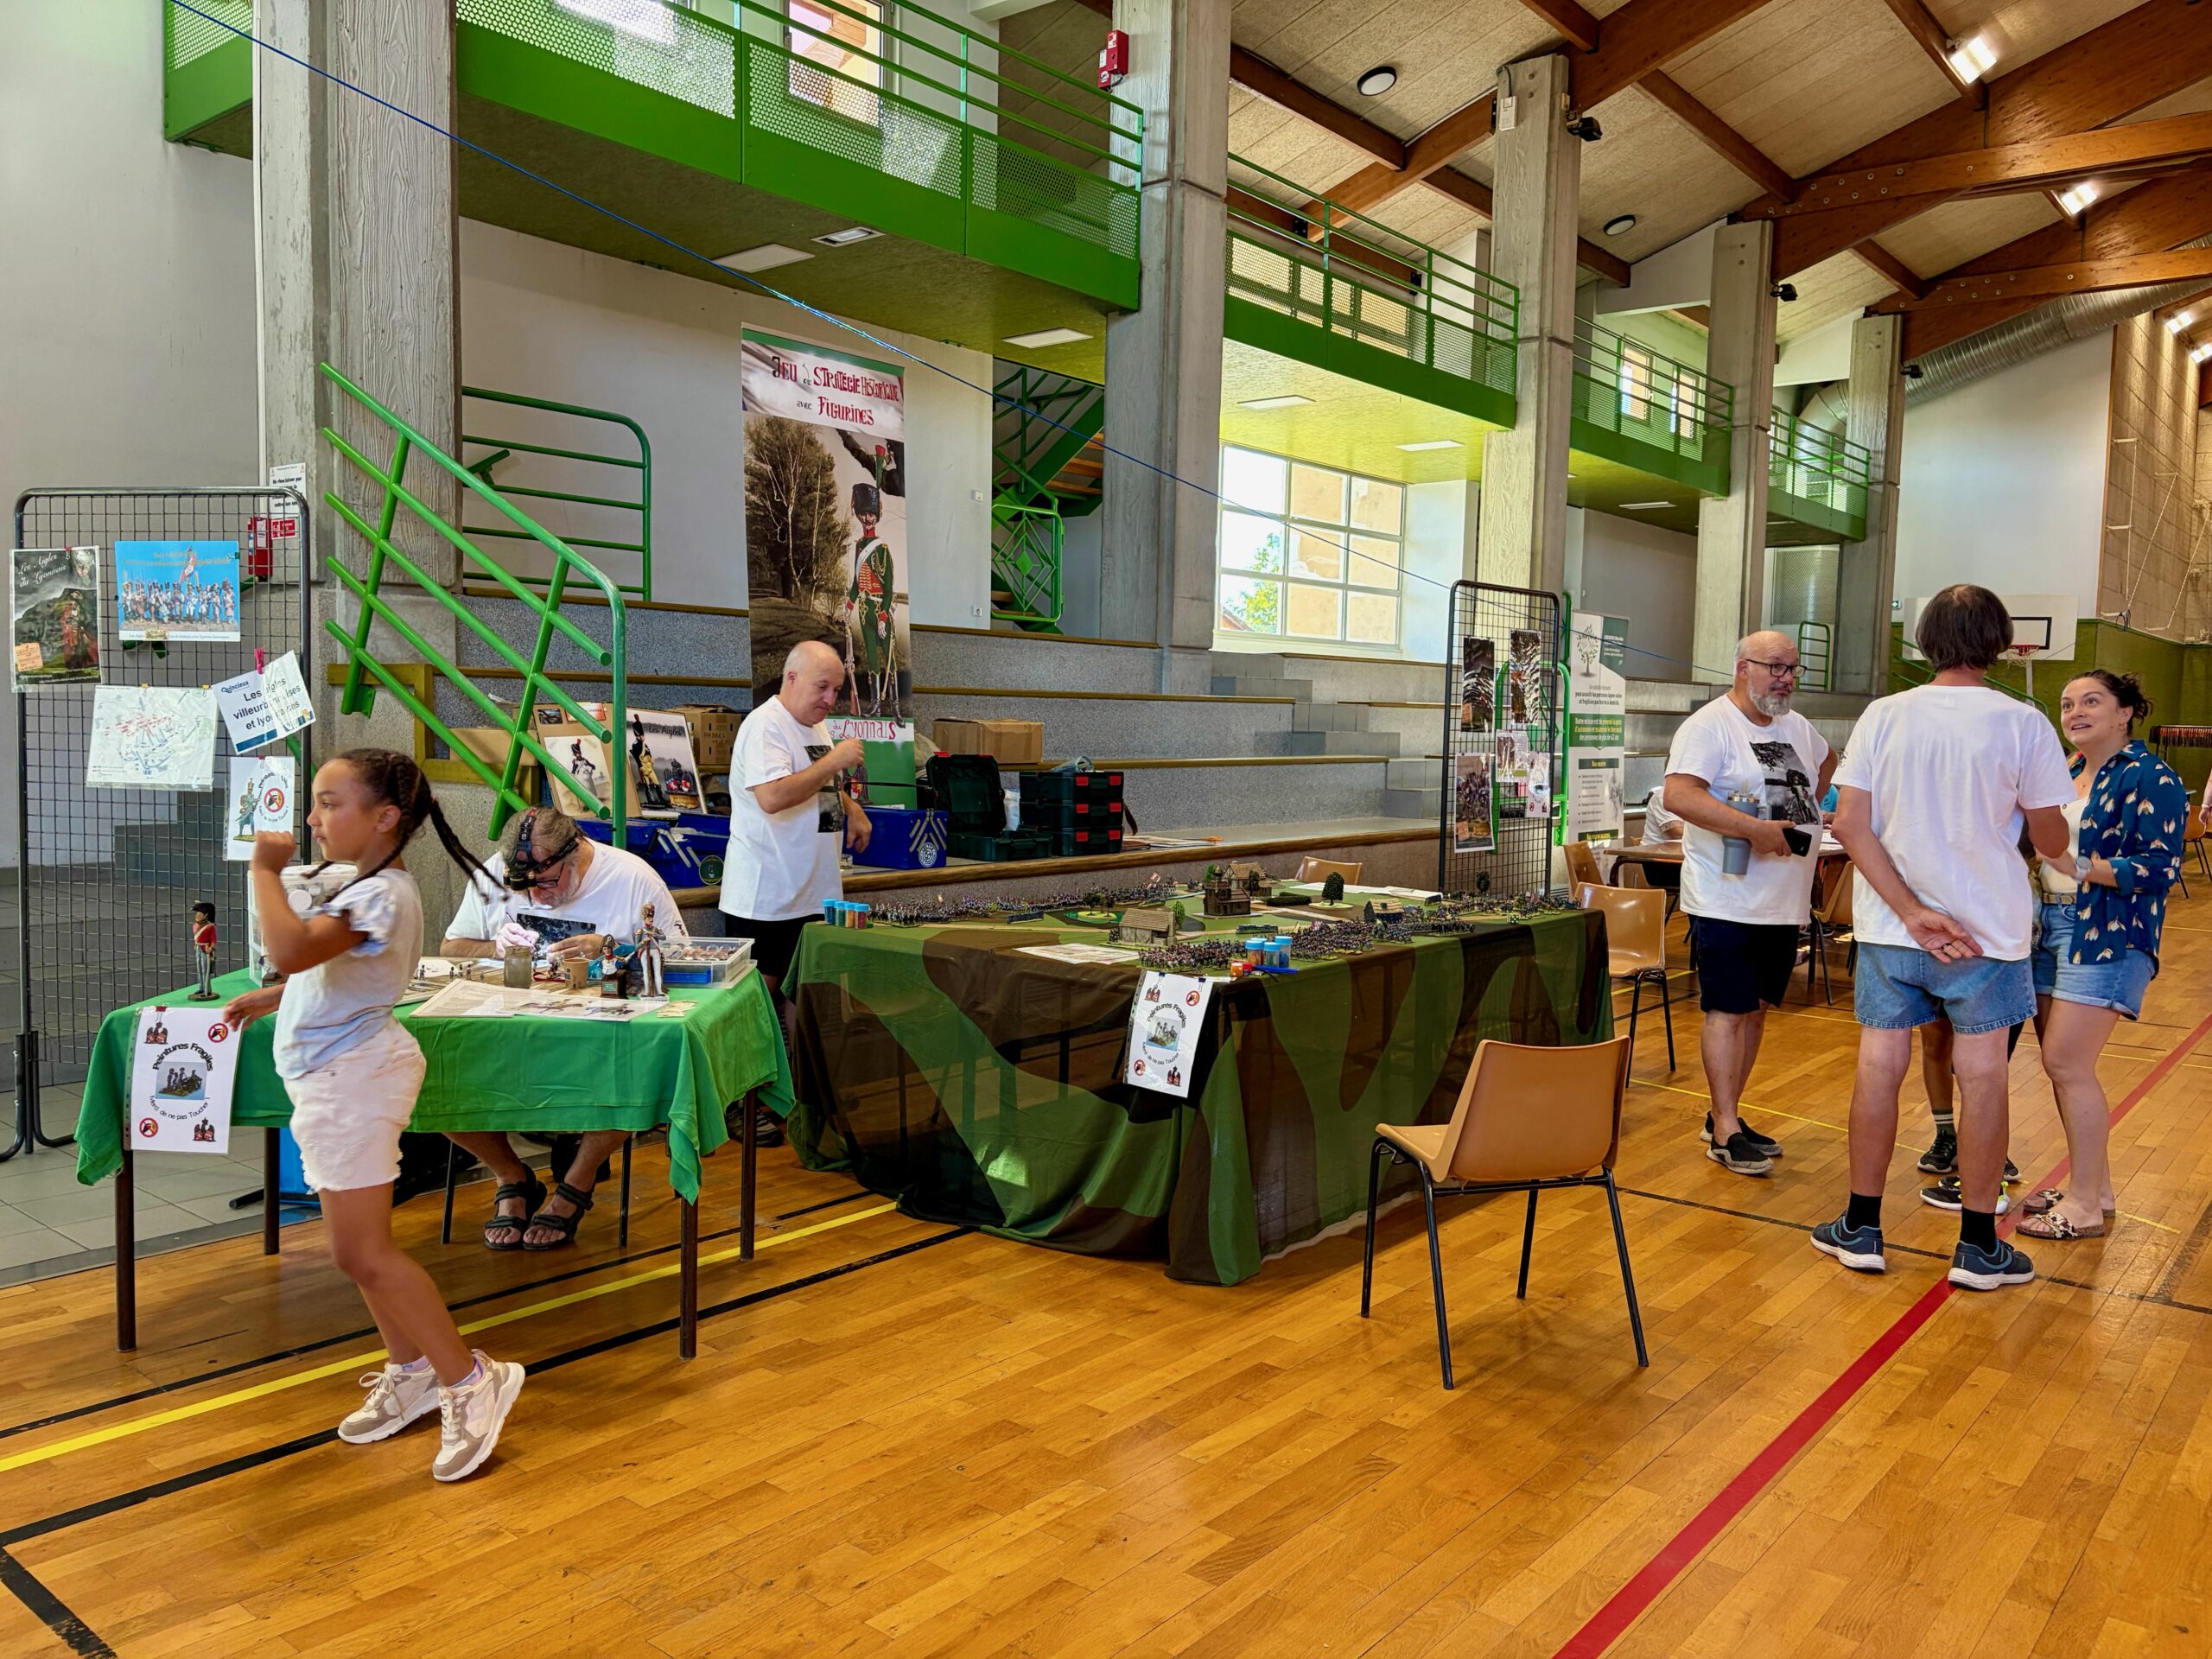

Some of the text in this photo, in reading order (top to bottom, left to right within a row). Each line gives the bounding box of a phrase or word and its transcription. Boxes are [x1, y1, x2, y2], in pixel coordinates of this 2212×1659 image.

[18, 563, 31, 575] Les
[221, 681, 249, 693] Quincieux
[244, 690, 262, 702] Les
[245, 721, 256, 730] et
[1147, 1003, 1173, 1022] Peintures
[152, 1043, 213, 1071] Peintures Fragiles
[188, 1102, 208, 1118] Toucher
